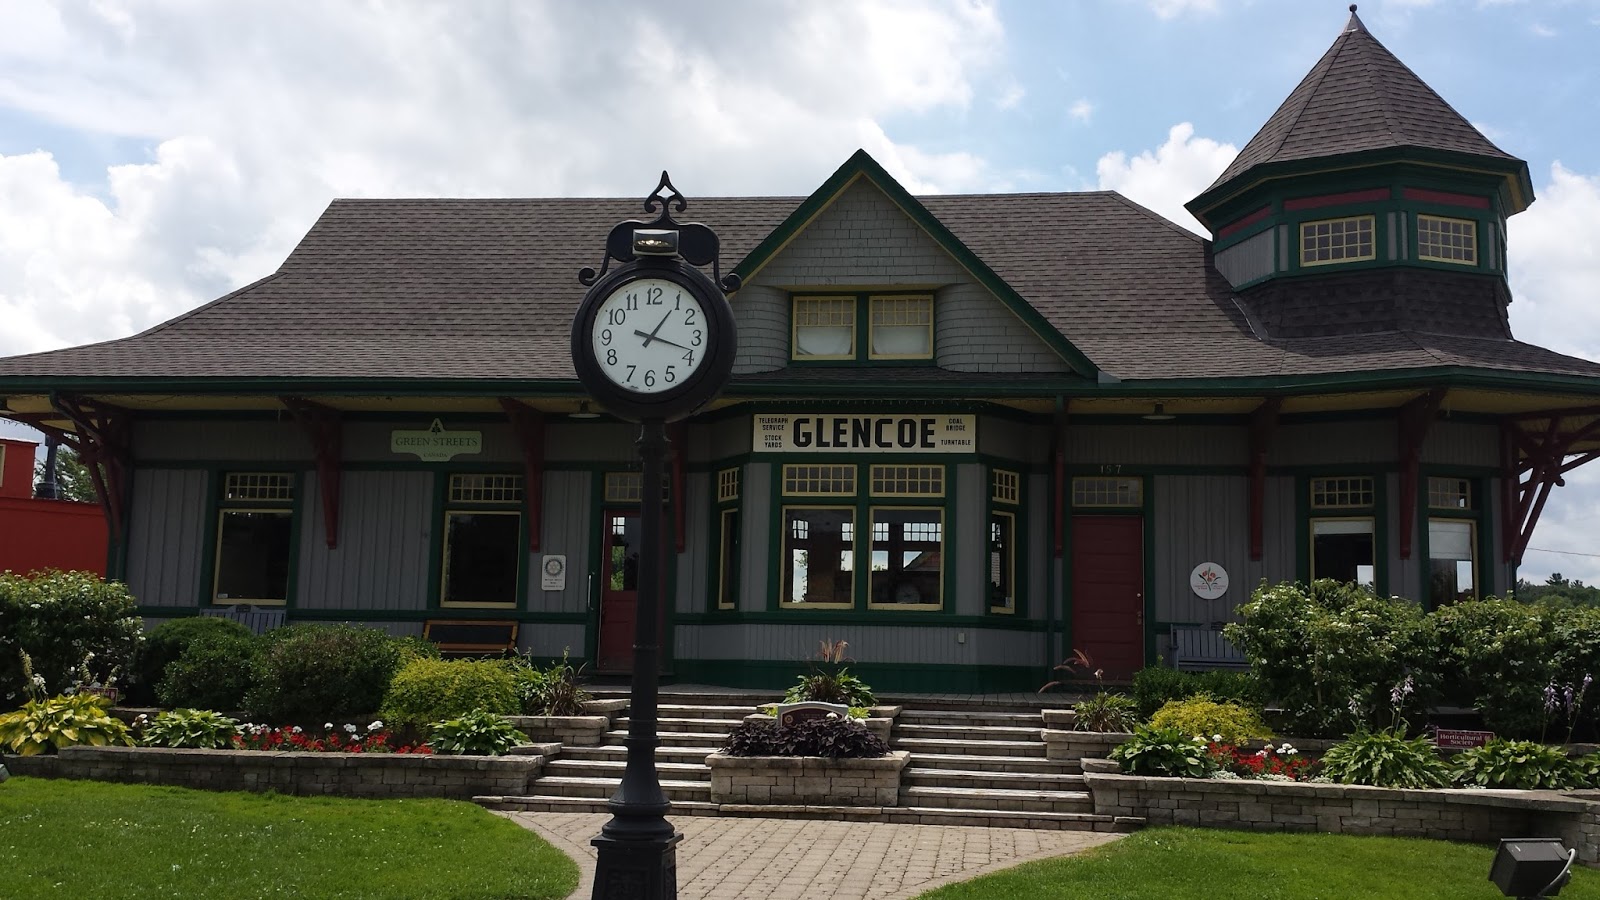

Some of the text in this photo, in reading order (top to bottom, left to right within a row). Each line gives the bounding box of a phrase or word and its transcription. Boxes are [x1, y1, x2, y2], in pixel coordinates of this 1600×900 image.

[626, 294, 638, 310] 11
[646, 288, 663, 305] 12
[674, 294, 680, 310] 1
[608, 308, 626, 325] 10
[684, 308, 696, 325] 2
[601, 329, 612, 346] 9
[691, 329, 702, 346] 3
[606, 349, 618, 366] 8
[682, 349, 695, 366] 4
[626, 365, 637, 382] 7
[644, 370, 656, 387] 6
[664, 365, 676, 383] 5
[793, 418, 936, 448] GLENCOE
[395, 437, 479, 447] GREEN STREETS
[1100, 464, 1121, 474] 157
